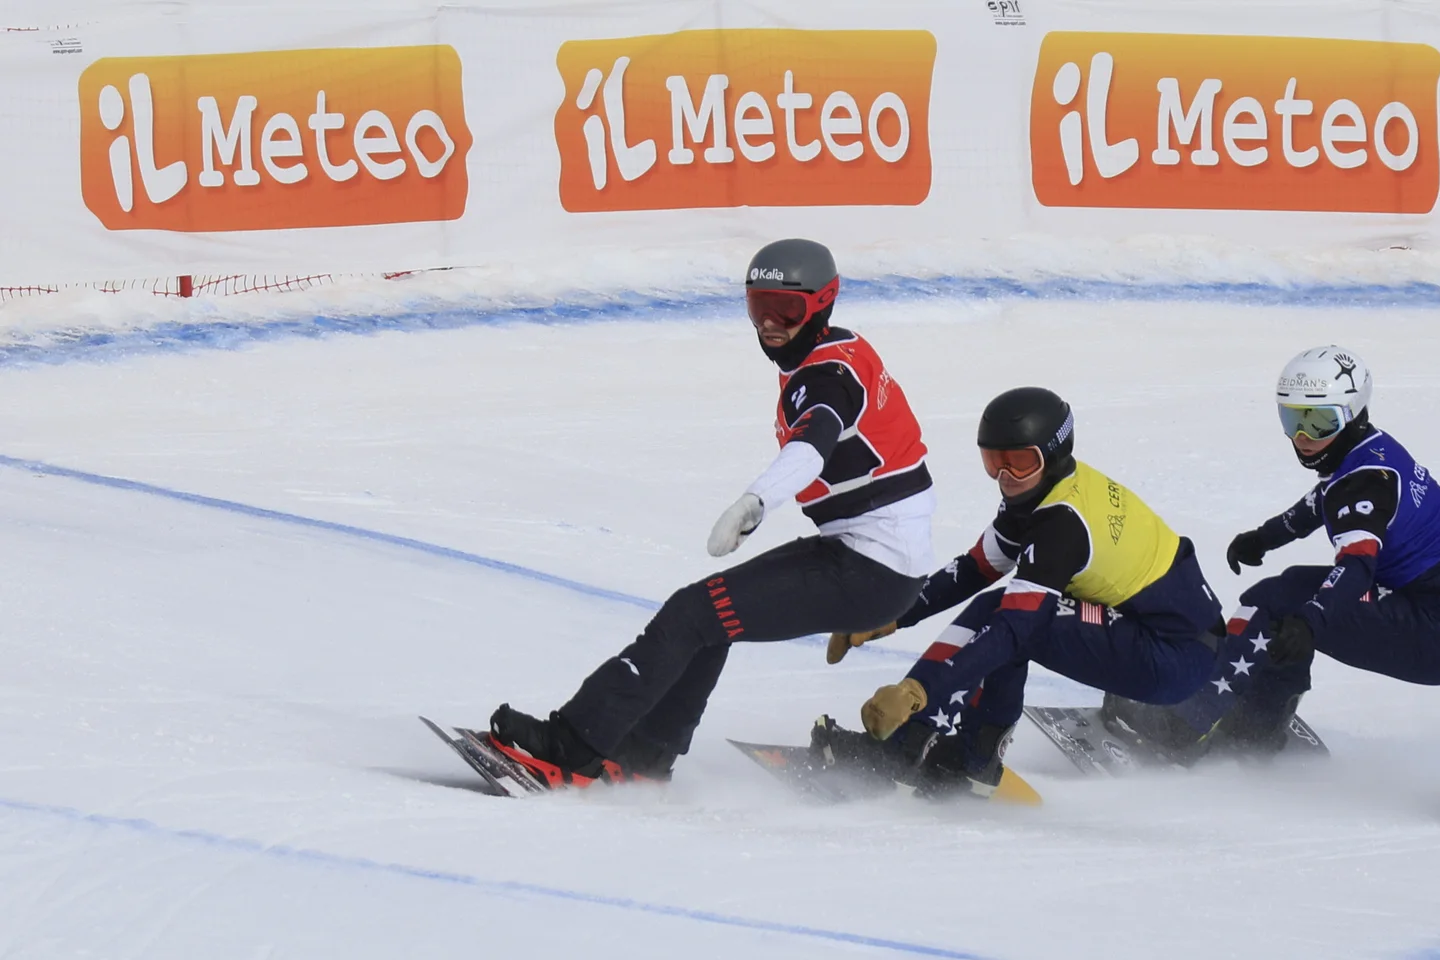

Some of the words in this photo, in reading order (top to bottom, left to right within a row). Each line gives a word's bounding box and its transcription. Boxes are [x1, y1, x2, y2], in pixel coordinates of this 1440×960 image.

[665, 69, 910, 165] Meteo
[1151, 77, 1419, 171] Meteo
[196, 90, 455, 187] Meteo
[759, 267, 784, 281] Kalia
[791, 385, 807, 409] 2
[1024, 543, 1035, 564] 1
[706, 577, 744, 638] CANADA
[1056, 597, 1075, 616] SA
